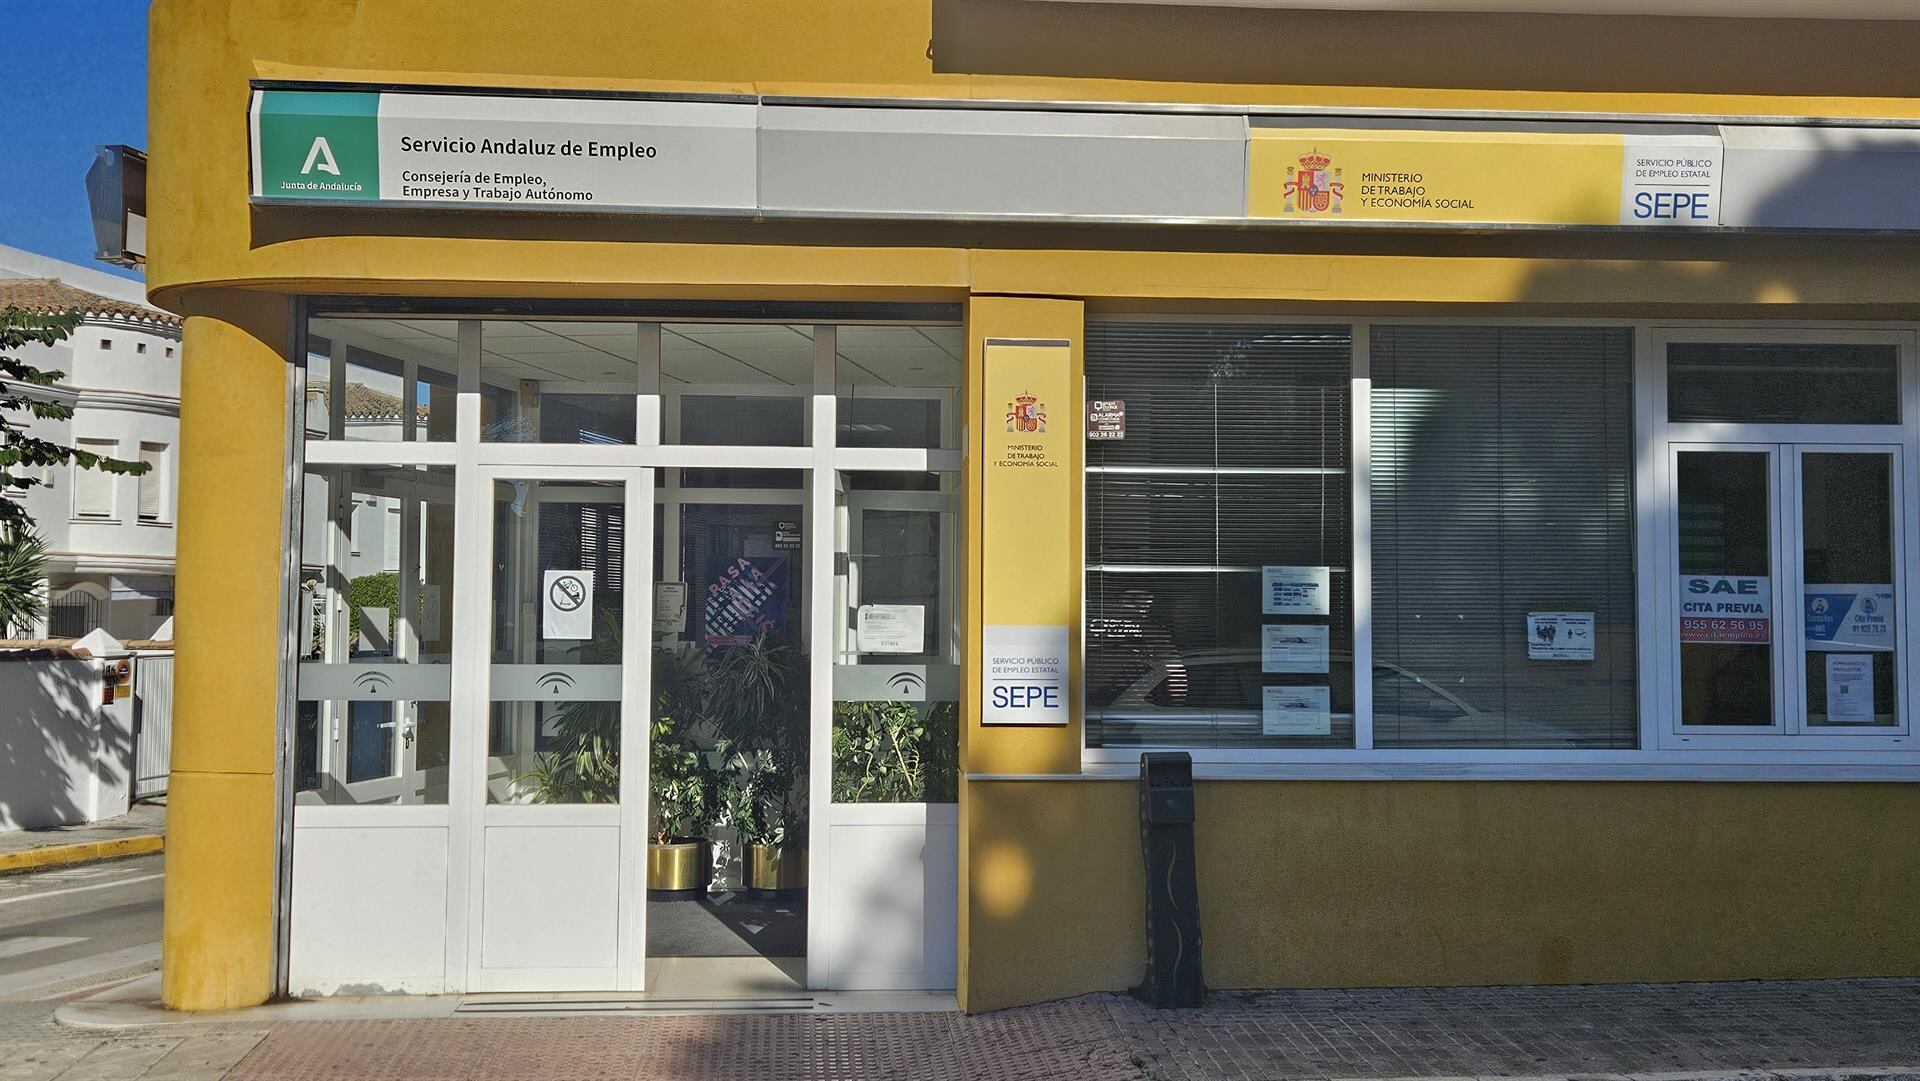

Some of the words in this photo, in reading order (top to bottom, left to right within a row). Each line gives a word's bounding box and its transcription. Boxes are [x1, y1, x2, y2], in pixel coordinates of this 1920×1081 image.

[401, 136, 476, 153] Servicio
[480, 138, 556, 155] Andaluz
[560, 140, 583, 156] de
[588, 141, 657, 161] Empleo
[1636, 158, 1674, 168] SERVICIO
[1676, 157, 1712, 168] PÚBLICO
[402, 170, 471, 185] Consejería
[474, 172, 491, 184] de
[493, 172, 547, 187] Empleo,
[1361, 173, 1423, 183] MINISTERIO
[1635, 169, 1647, 178] DE
[1648, 169, 1679, 178] EMPLEO
[1680, 170, 1711, 178] ESTATAL
[281, 181, 305, 190] Junta
[307, 181, 318, 190] de
[320, 182, 362, 191] Andalucía
[1361, 185, 1376, 195] DE
[1378, 186, 1426, 198] TRABAJO
[402, 185, 459, 199] Empresa
[463, 187, 470, 201] y
[473, 187, 521, 202] Trabajo
[525, 188, 593, 201] Autónomo
[1361, 197, 1368, 207] Y
[1370, 196, 1432, 208] ECONOMÍA
[1435, 199, 1475, 209] SOCIAL
[1633, 191, 1710, 219] SEPE
[1017, 452, 1045, 460] TRABAJO
[1687, 579, 1758, 595] SAE
[1683, 602, 1713, 613] CITA
[1716, 602, 1763, 614] PREVIA
[1684, 620, 1708, 630] 955
[1711, 620, 1726, 630] 62
[1730, 620, 1745, 630] 56
[1749, 620, 1764, 631] 95
[992, 657, 1025, 665] SERVICIO
[1027, 656, 1060, 665] PÚBLICO
[992, 685, 1060, 709] SEPE
